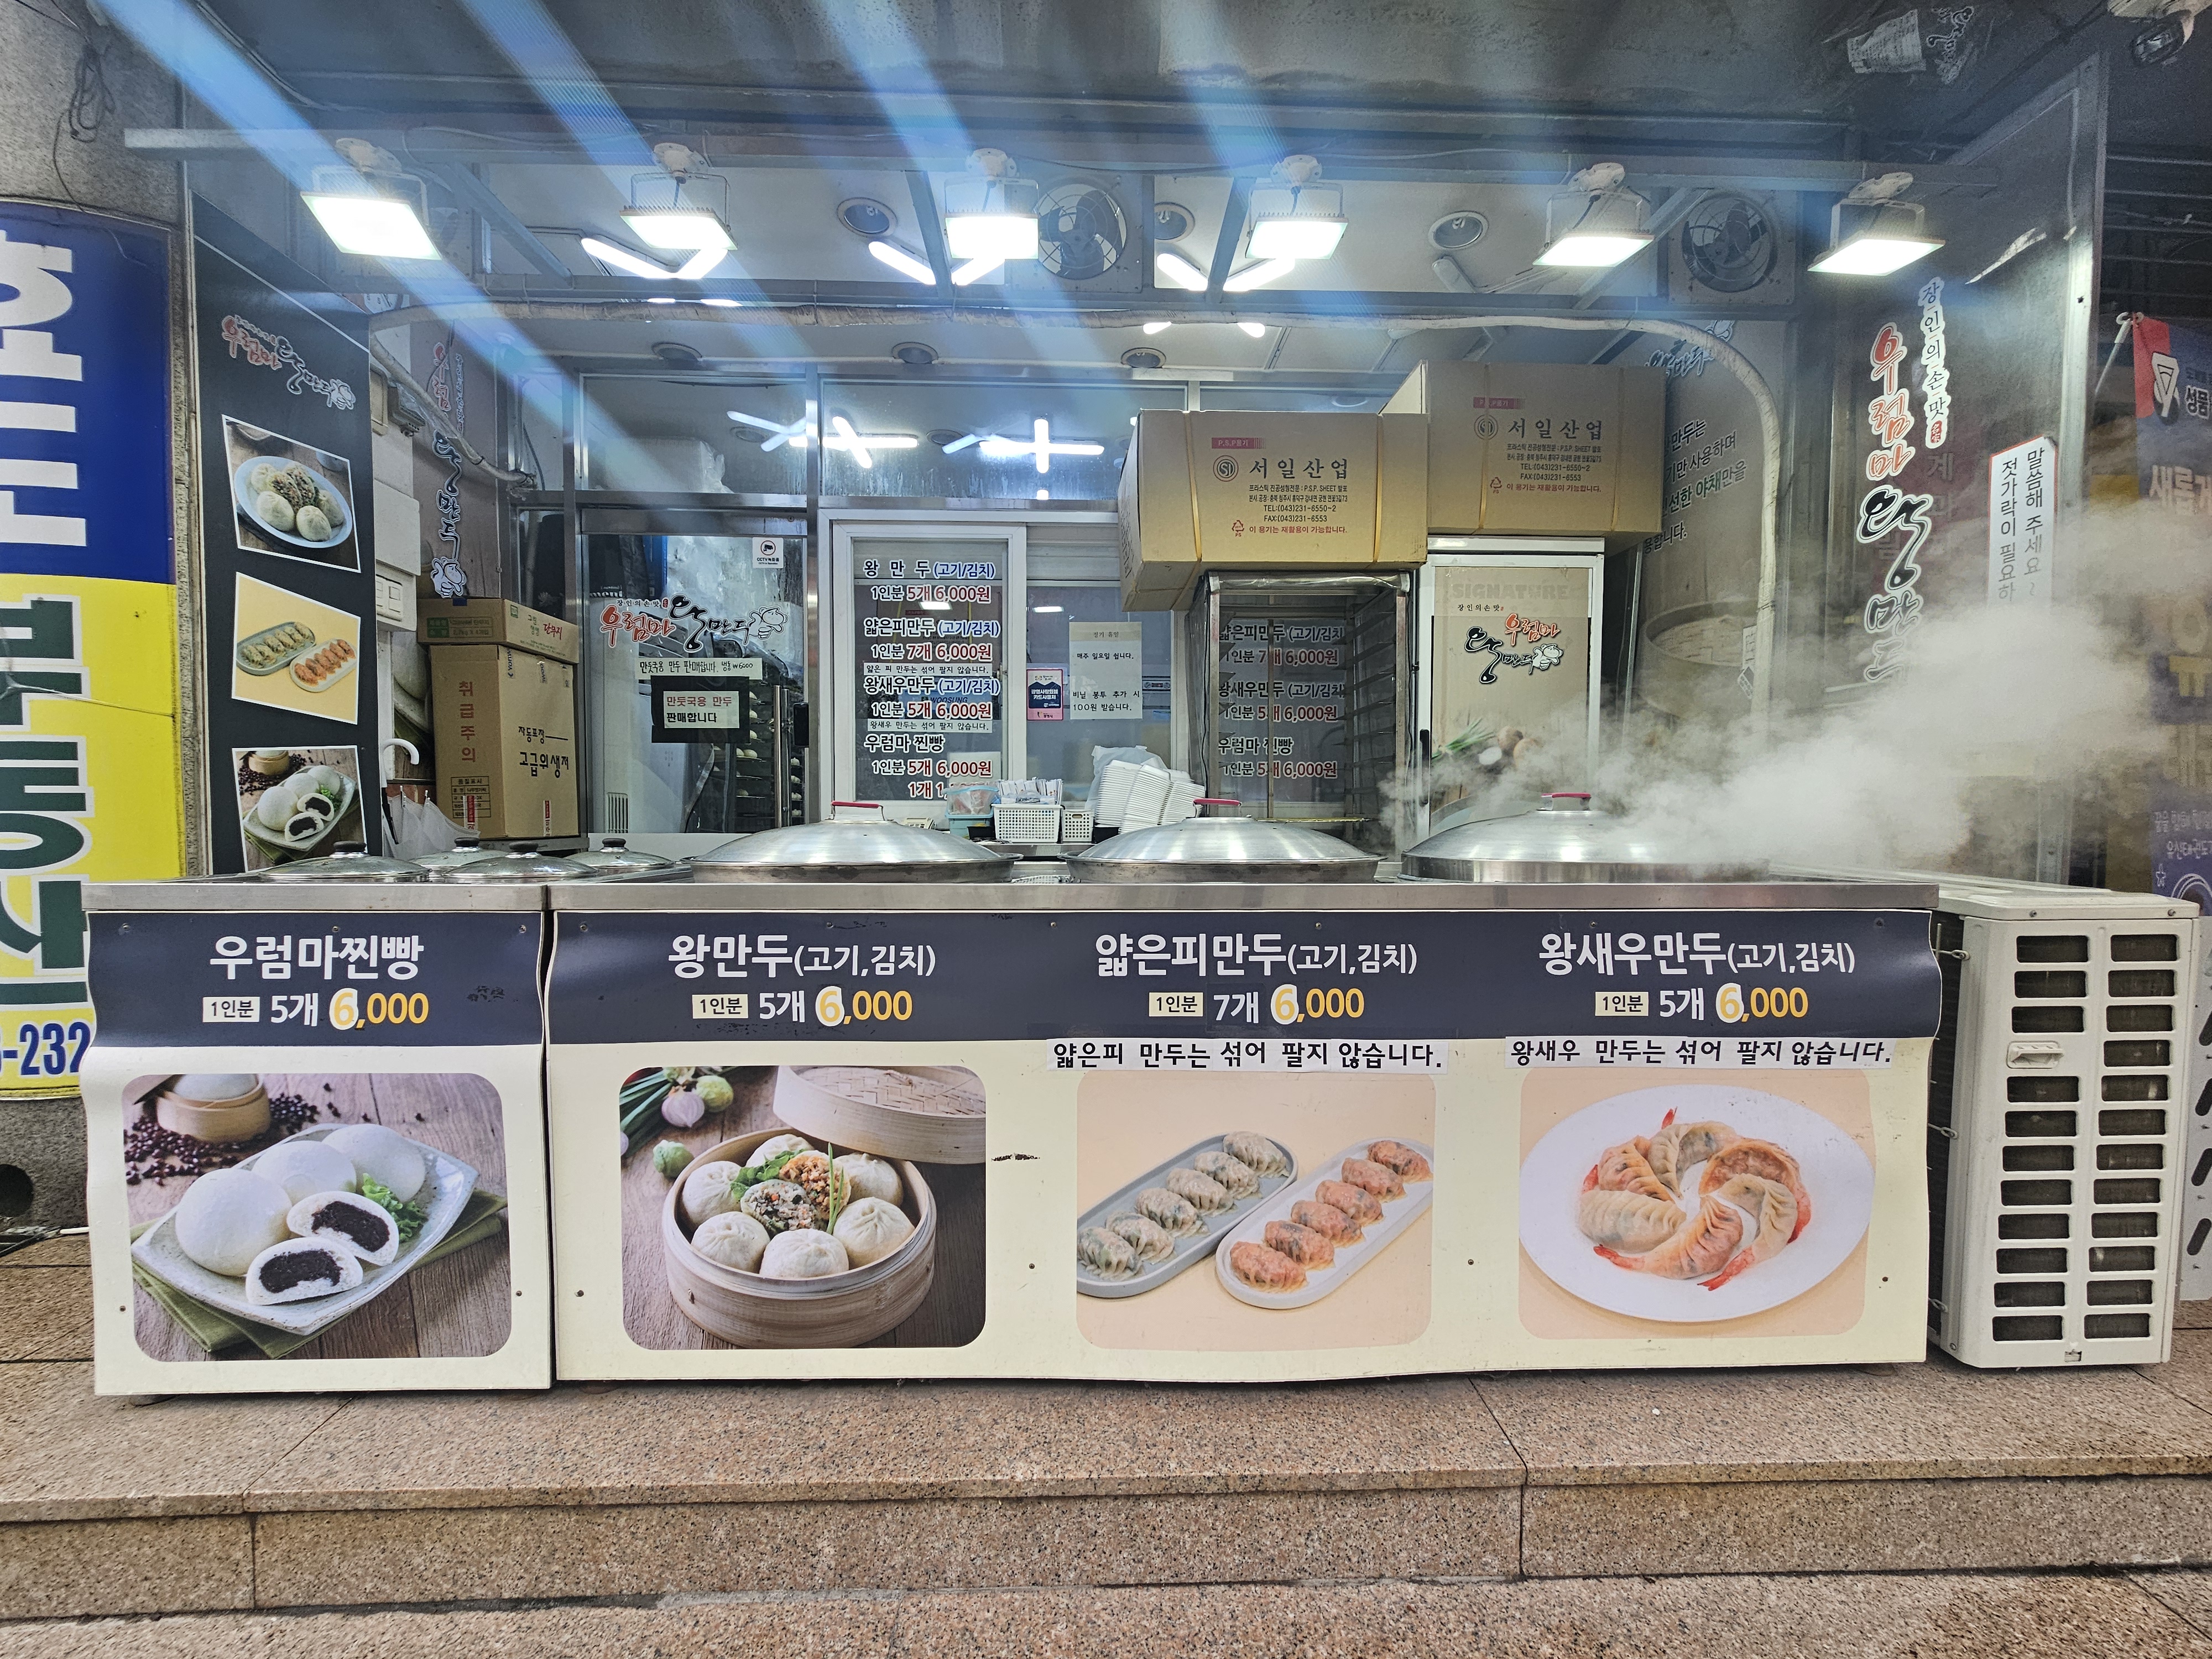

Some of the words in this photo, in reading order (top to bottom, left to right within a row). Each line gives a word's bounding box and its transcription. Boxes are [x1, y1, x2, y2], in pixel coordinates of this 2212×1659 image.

[1922, 283, 1945, 420] 장인의손맛
[1868, 323, 1914, 480] 우럼마
[1508, 418, 1602, 440] 서일산업
[1689, 431, 1736, 469] 사용하며
[1249, 457, 1347, 479] 서일산업
[2025, 447, 2045, 508] 말씀해
[1696, 460, 1746, 498] 야채만을
[2001, 457, 2017, 536] 젓가락이
[864, 560, 878, 577] 왕
[891, 560, 904, 577] 만
[916, 561, 930, 578] 두
[934, 562, 995, 579] (고기/김치)
[872, 586, 903, 600] 1인분
[907, 586, 930, 602] 5개
[935, 586, 991, 602] 6,000원
[543, 623, 562, 640] 단무지
[601, 606, 676, 647] 우럼마
[864, 618, 935, 636] 얇은피만두
[937, 620, 1000, 637] (고기/김치)
[1505, 613, 1561, 645] 우럼마
[872, 644, 903, 658] 1인분
[907, 644, 931, 660] 7개
[937, 644, 992, 660] 6,000원
[1286, 650, 1338, 666] 6,000원
[669, 661, 680, 673] 만두
[867, 665, 880, 673] 얇은
[885, 665, 892, 673] 피
[896, 665, 917, 673] 만두는
[921, 665, 935, 674] 섞어
[939, 665, 953, 674] 팔지
[957, 665, 989, 674] 않습니다.
[864, 677, 935, 694] 왕새우만두
[937, 679, 1000, 695] (고기/김치)
[1073, 690, 1087, 699] 비닐
[1092, 690, 1107, 699] 봉투
[1113, 690, 1127, 699] 추가
[1133, 690, 1140, 699] 시
[666, 696, 706, 707] 만둣국용
[712, 697, 732, 707] 만두
[872, 703, 903, 717] 1인분
[908, 702, 931, 718] 5개
[937, 703, 992, 719] 6,000원
[1073, 703, 1097, 712] 100원
[1101, 703, 1132, 712] 받습니다.
[459, 681, 476, 762] 취급주의
[666, 712, 717, 723] 판매합니다
[1285, 706, 1337, 721] 6,000원
[518, 726, 545, 744] 자동포장
[870, 722, 891, 730] 왕새우
[896, 722, 917, 730] 만두는
[921, 722, 935, 731] 섞어
[939, 722, 953, 730] 팔지
[957, 722, 989, 731] 않습니다.
[864, 734, 910, 752] 우럼마
[914, 734, 943, 752] 찐빵
[1219, 738, 1259, 754] 우럼마
[872, 760, 904, 774] 1인분
[908, 759, 931, 775] 5개
[937, 760, 992, 776] 6,000원
[1285, 762, 1337, 778] 6,000원
[910, 782, 932, 799] 1개
[210, 935, 424, 981] 우럼마찐빵
[669, 934, 936, 978] 왕만두(고기,김치)
[1095, 933, 1417, 977] 얇은피만두(고기,김치)
[1539, 932, 1855, 975] 왕새우만두(고기,김치)
[211, 1000, 254, 1018] 1인분
[271, 993, 318, 1026] 5개
[330, 988, 429, 1030] 6,000
[700, 998, 743, 1015] 1인분
[759, 990, 805, 1023] 5개
[816, 986, 912, 1026] 6,000
[1156, 996, 1198, 1013] 1인분
[1214, 992, 1259, 1024] 7개
[1271, 984, 1365, 1025] 6,000
[1602, 996, 1644, 1013] 1인분
[1659, 988, 1704, 1021] 5개
[1715, 982, 1808, 1023] 6,000
[1053, 1043, 1123, 1069] 얇은피
[1139, 1043, 1210, 1068] 만두는
[1220, 1041, 1266, 1068] 섞어
[1282, 1042, 1327, 1068] 팔지
[1338, 1043, 1442, 1070] 않습니다.
[1511, 1040, 1580, 1067] 왕새우
[1595, 1040, 1666, 1064] 만두는
[1675, 1040, 1721, 1066] 섞어
[1736, 1040, 1781, 1064] 팔지
[1791, 1040, 1891, 1067] 않습니다.
